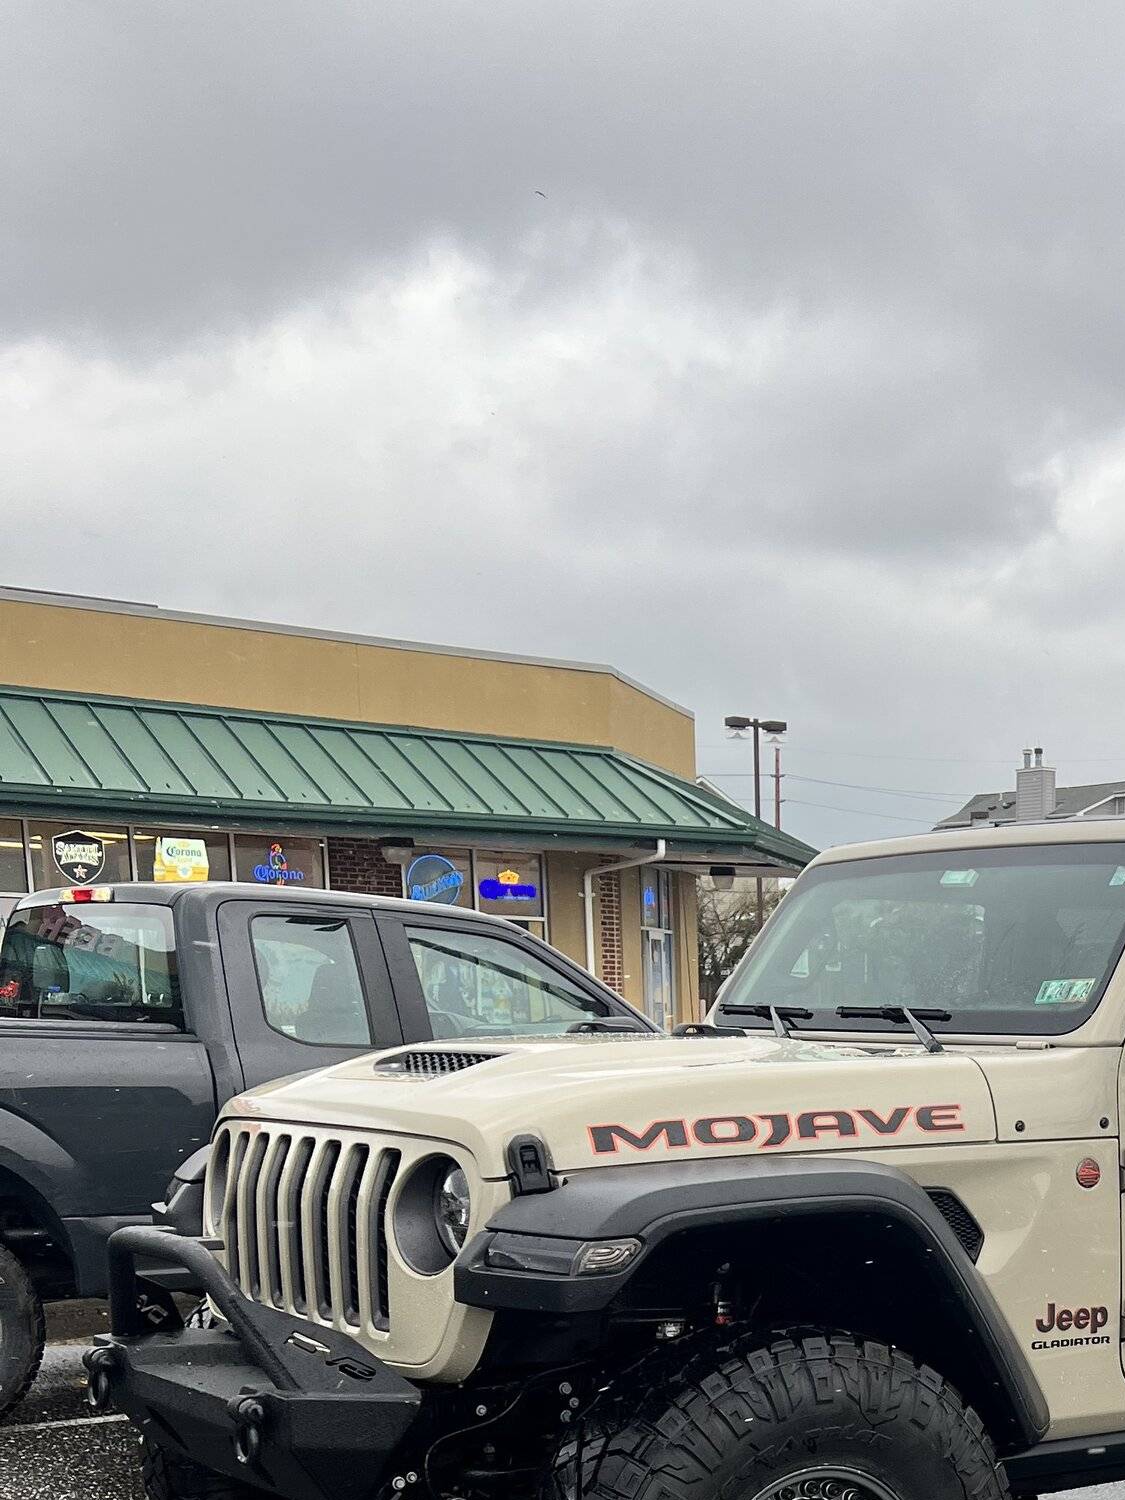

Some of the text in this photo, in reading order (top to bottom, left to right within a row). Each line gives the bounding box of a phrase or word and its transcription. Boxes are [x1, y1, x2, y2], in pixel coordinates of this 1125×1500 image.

[166, 846, 202, 858] Corona
[253, 864, 305, 883] Corona
[587, 1104, 966, 1155] MOJAVE
[1036, 1303, 1108, 1333] Jeep
[1031, 1336, 1111, 1350] GLADIATOR
